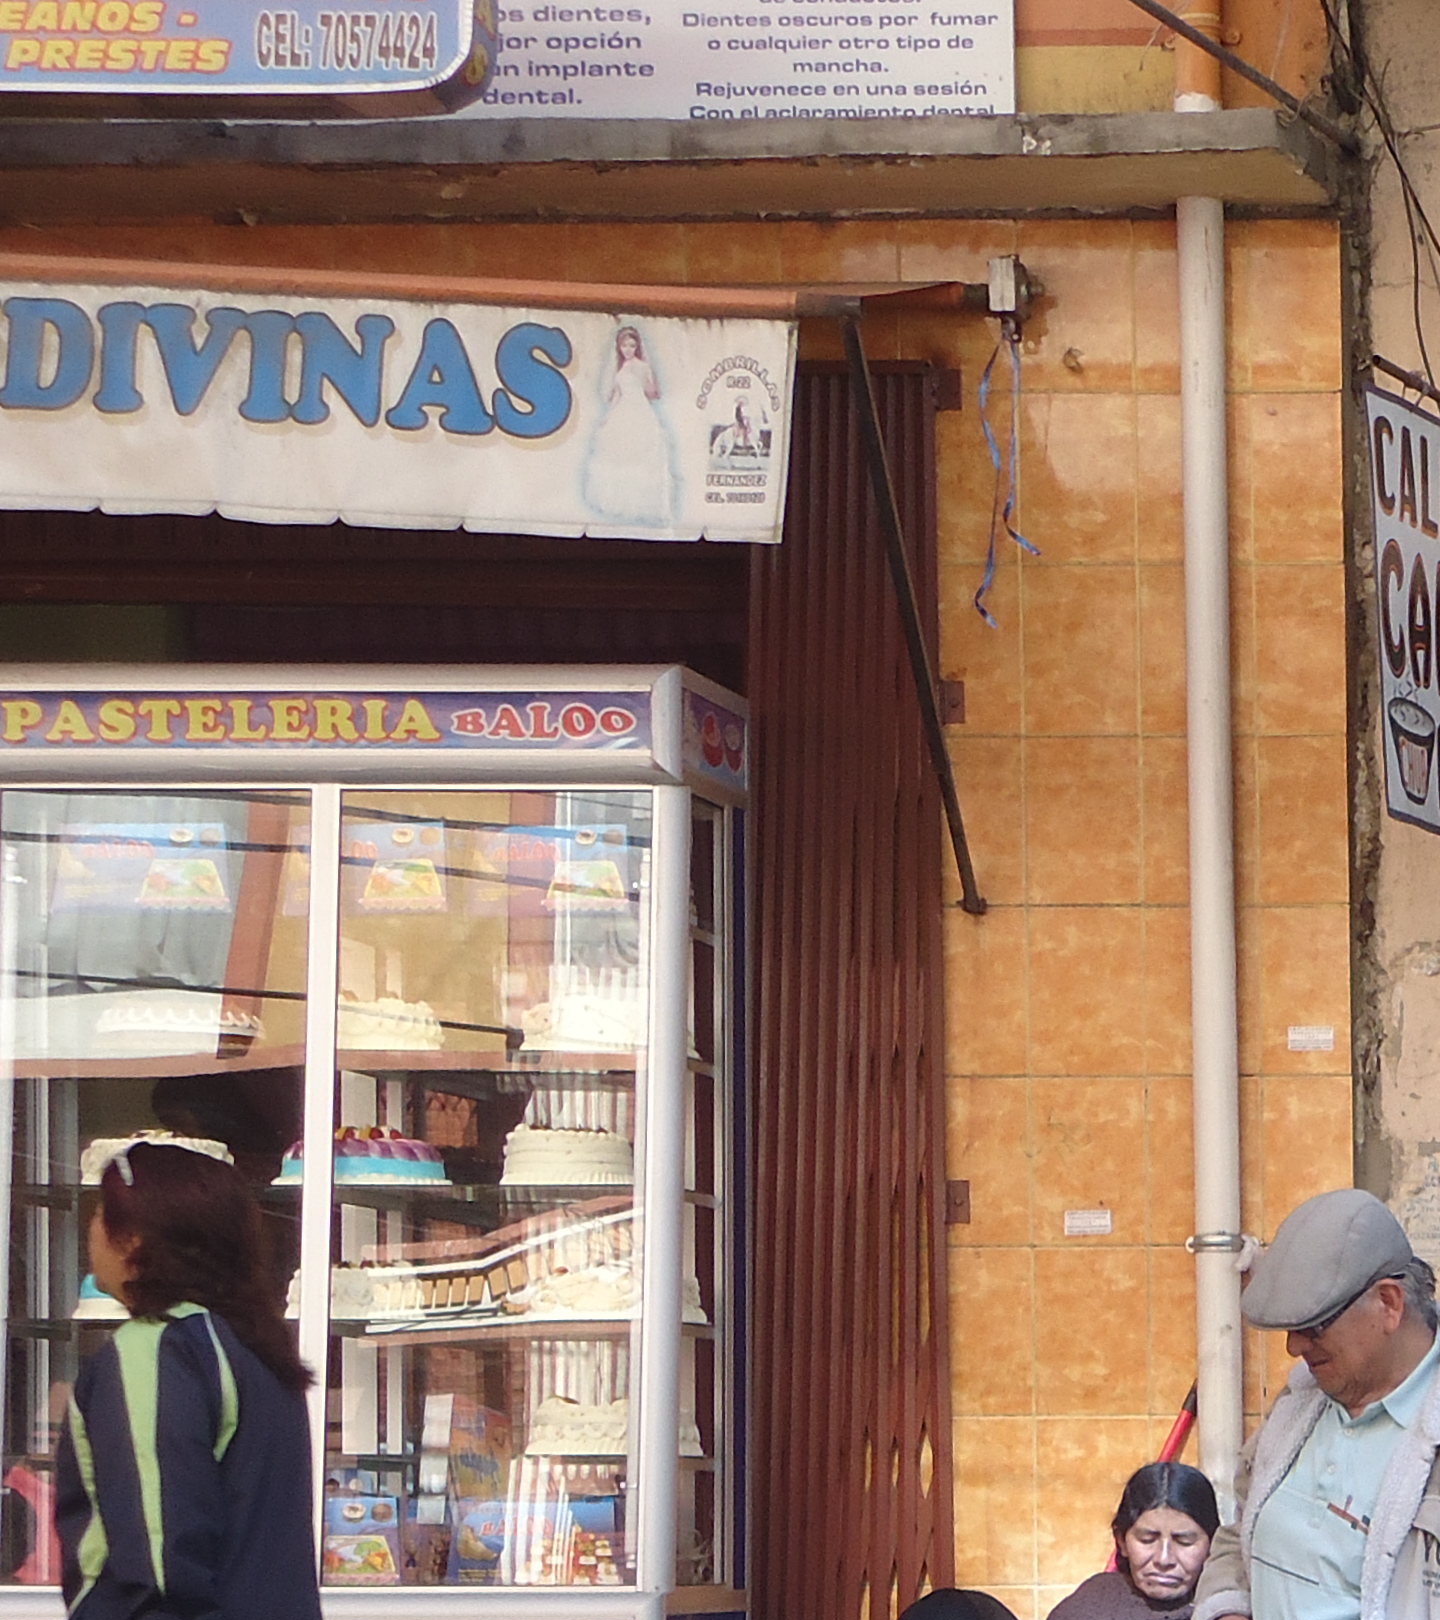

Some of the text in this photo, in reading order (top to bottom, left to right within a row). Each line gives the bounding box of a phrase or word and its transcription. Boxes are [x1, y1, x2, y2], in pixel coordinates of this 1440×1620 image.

[533, 6, 651, 25] dientes,
[682, 12, 998, 29] Dientes oscuros por fumar
[257, 11, 437, 70] CEL: 70574424
[498, 31, 642, 53] jor opción
[707, 35, 974, 53] o cualquier otro tipo de
[6, 38, 231, 72] PRESTES
[528, 60, 655, 80] implante
[793, 58, 889, 73] mancha.
[483, 88, 582, 104] dental.
[695, 80, 988, 99] Rejuvenece en una sesión
[689, 105, 734, 119] Con
[765, 104, 916, 118] aclaramiento
[0, 297, 573, 438] DIVINAS
[2, 697, 638, 744] PASTELERIA BALOO
